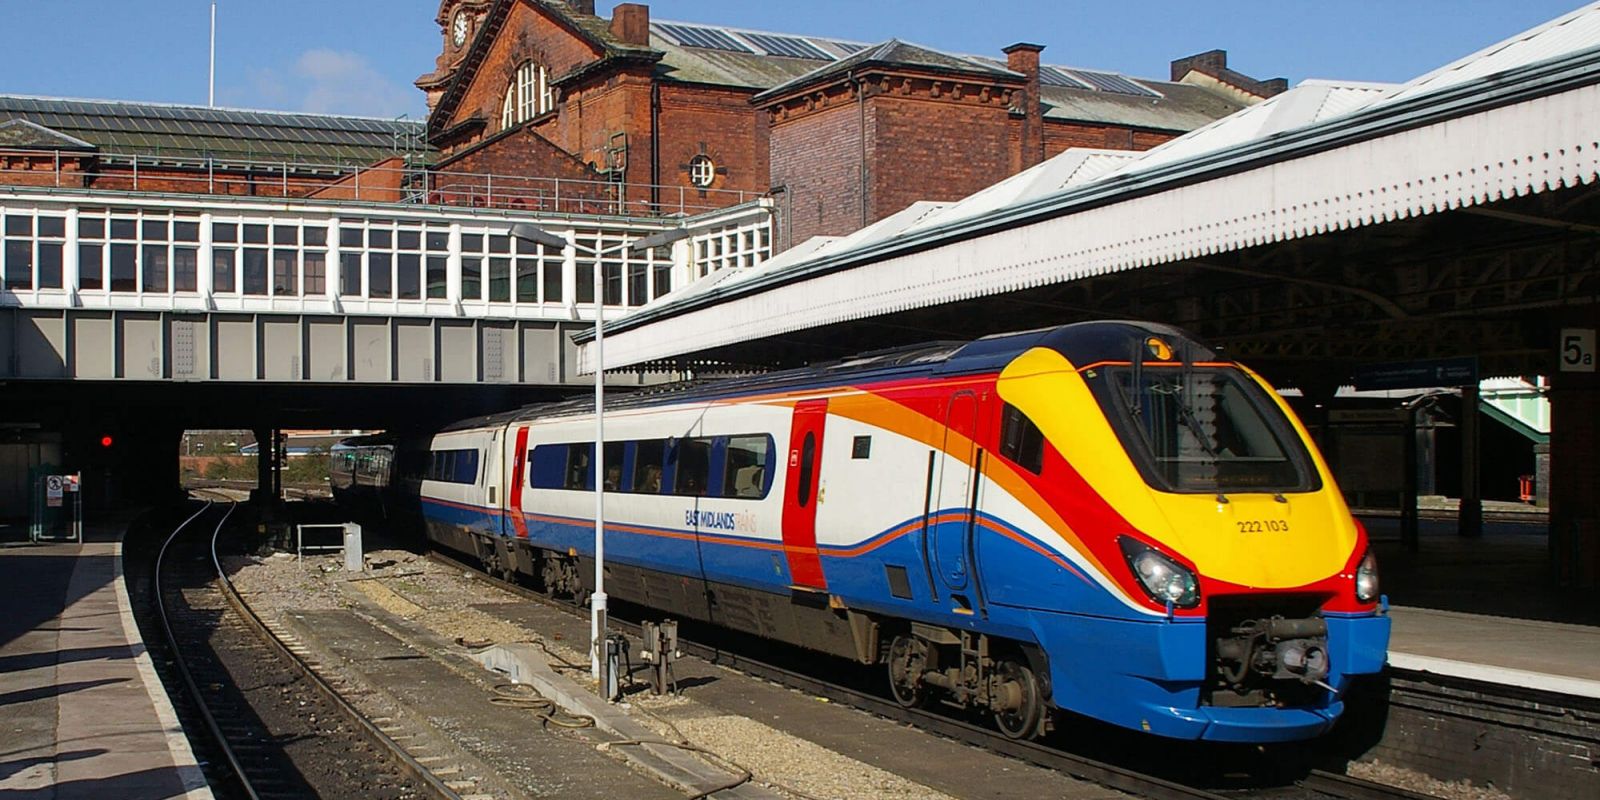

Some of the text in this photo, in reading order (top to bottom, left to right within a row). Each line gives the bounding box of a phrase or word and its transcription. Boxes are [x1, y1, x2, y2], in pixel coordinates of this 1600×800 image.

[686, 510, 699, 526] EAST
[700, 511, 735, 530] MIDLANDS
[1237, 520, 1289, 533] 222 103
